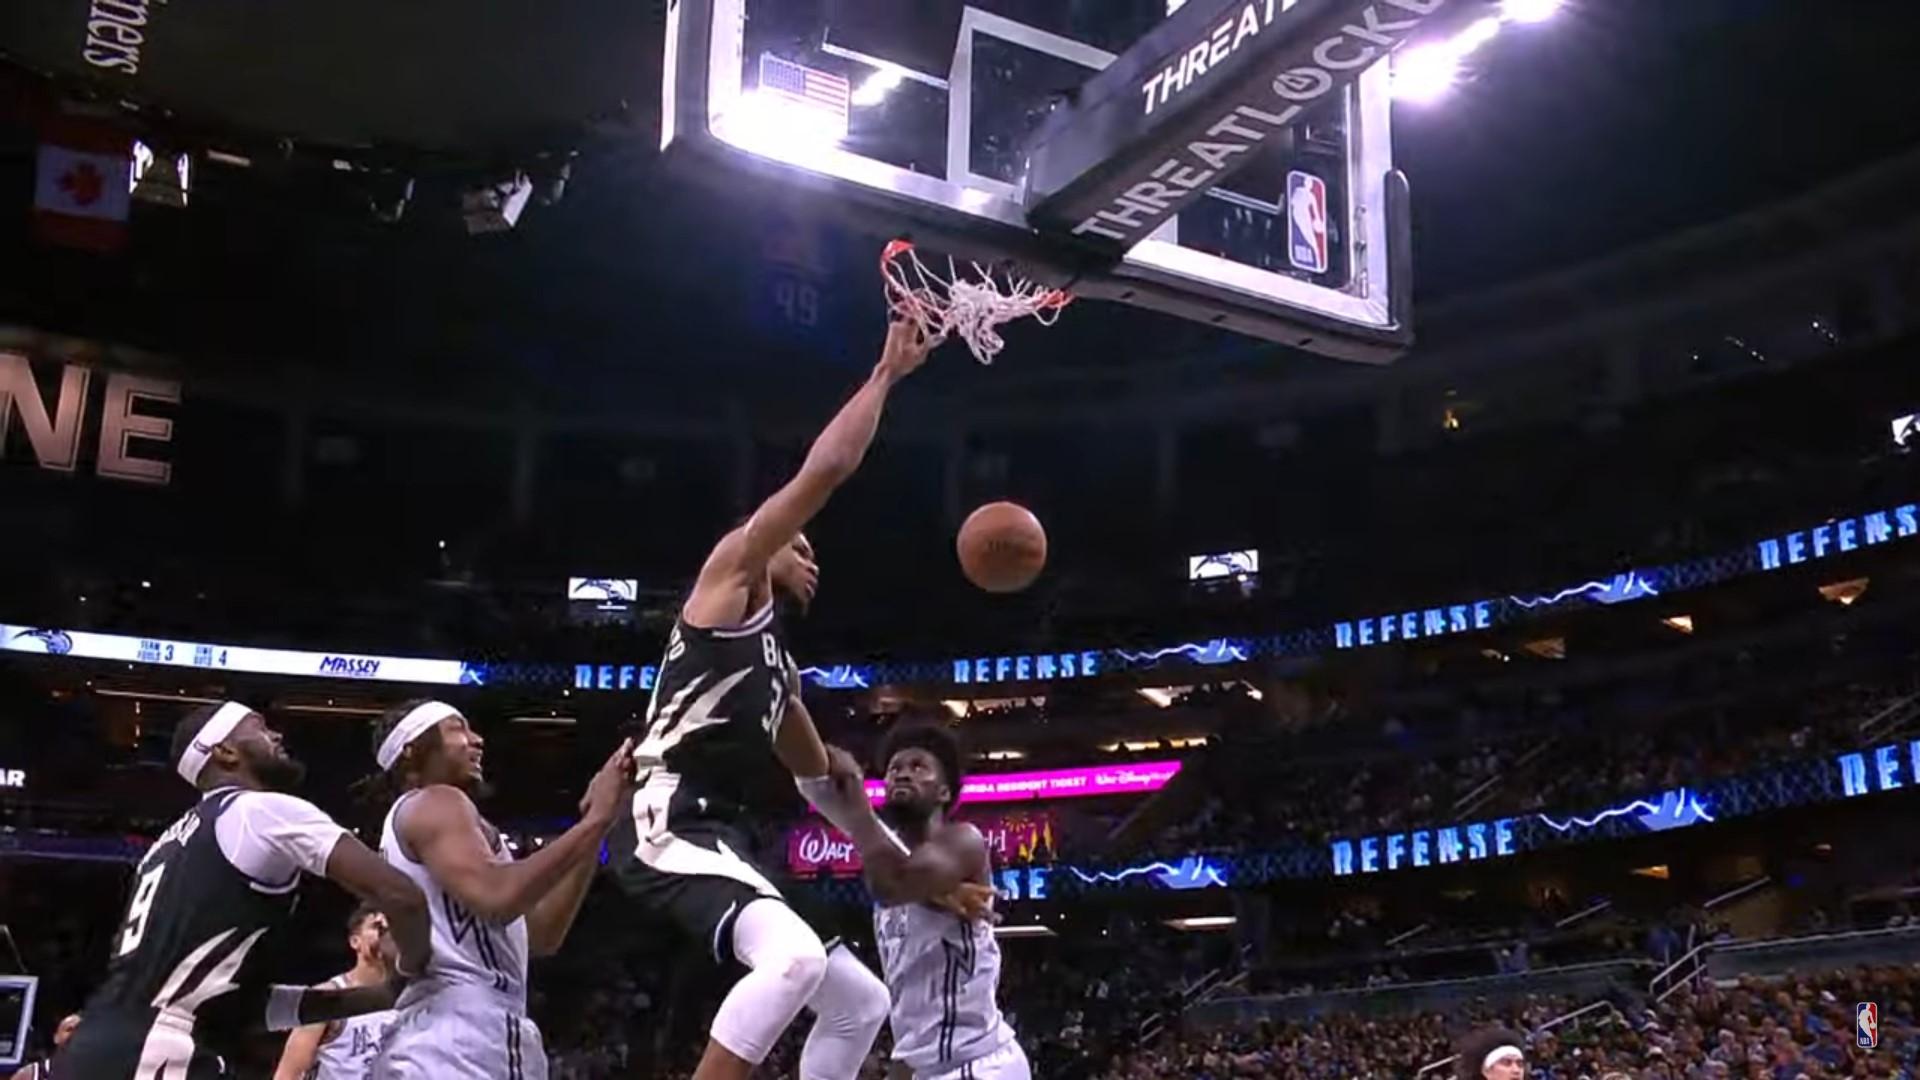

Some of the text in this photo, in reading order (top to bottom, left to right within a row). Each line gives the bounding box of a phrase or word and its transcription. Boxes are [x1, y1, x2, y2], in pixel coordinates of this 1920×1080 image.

[83, 0, 148, 74] ners
[0, 352, 182, 485] NE
[1334, 600, 1492, 649] DEFENSE
[165, 645, 174, 661] 3
[219, 650, 227, 666] 4
[320, 656, 380, 673] MASSEY
[953, 651, 1097, 684] DEFENSE
[574, 664, 656, 690] DEFE
[1332, 818, 1516, 876] DEFENSE
[119, 862, 166, 956] 9
